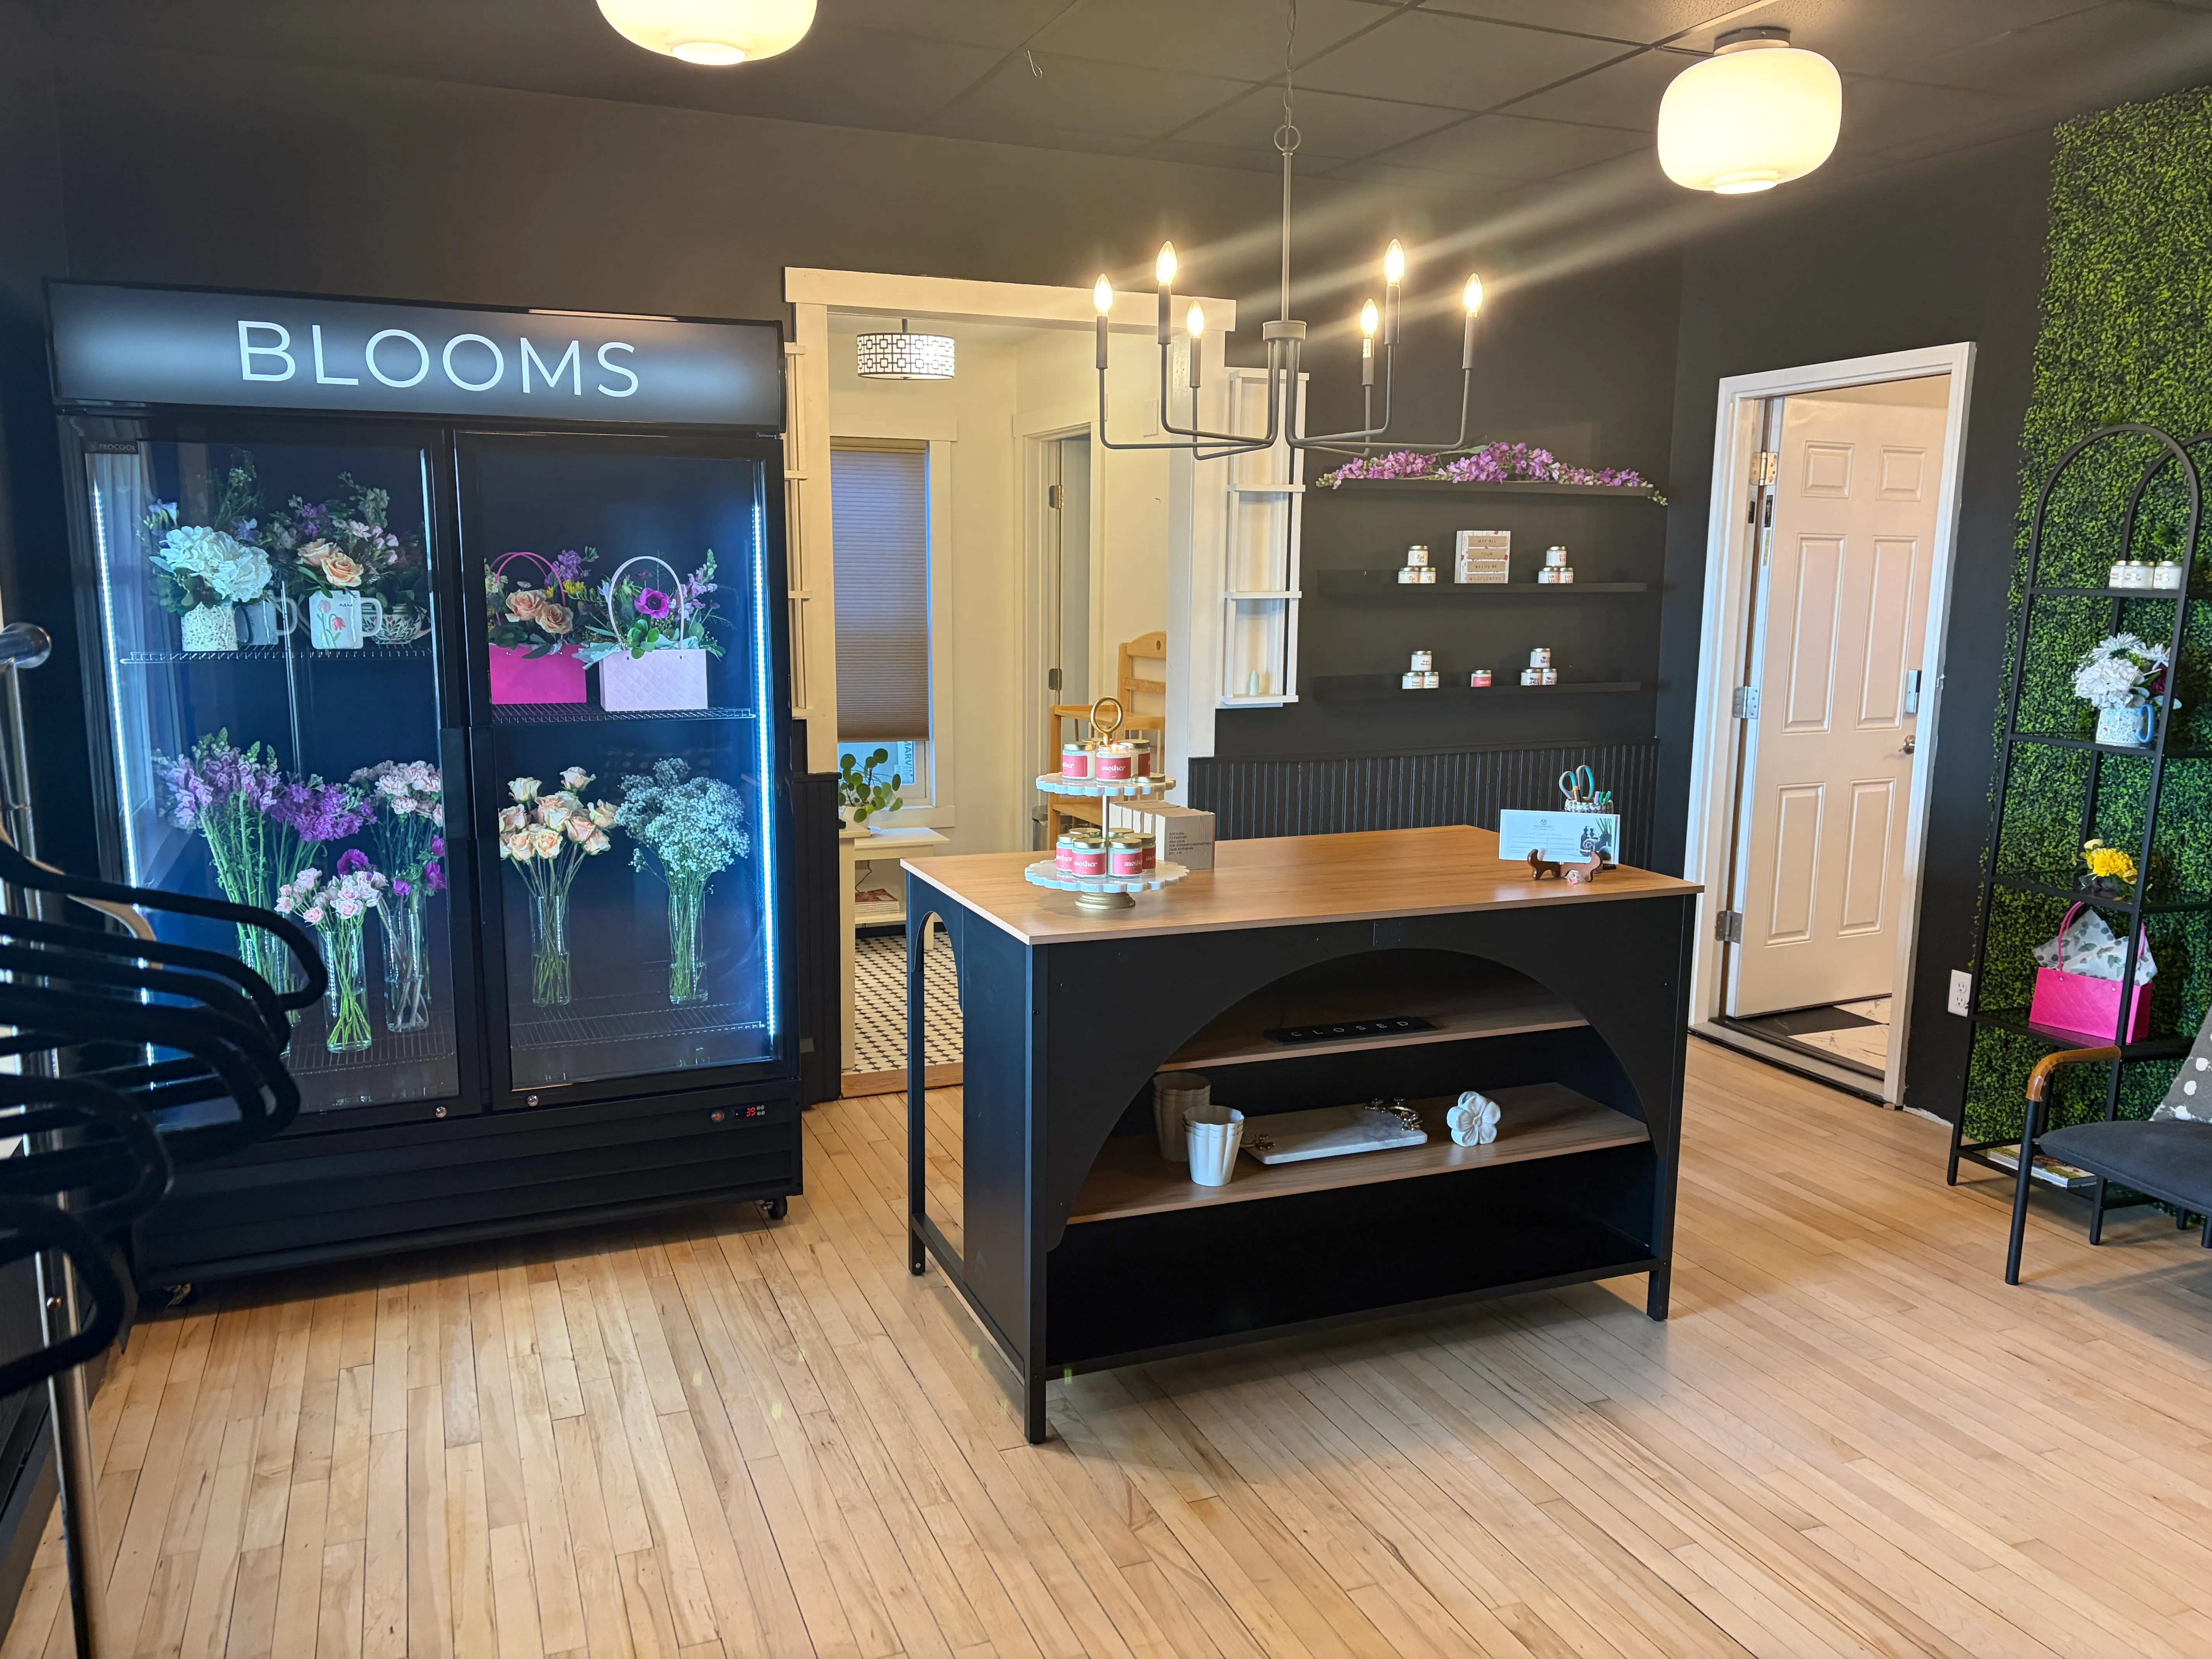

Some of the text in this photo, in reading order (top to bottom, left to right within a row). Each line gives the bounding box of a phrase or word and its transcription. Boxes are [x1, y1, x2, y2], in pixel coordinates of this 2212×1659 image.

[237, 320, 639, 397] BLOOMS
[1074, 858, 1097, 867] mother
[1291, 1021, 1408, 1036] CLOSED
[746, 1107, 755, 1116] 39
